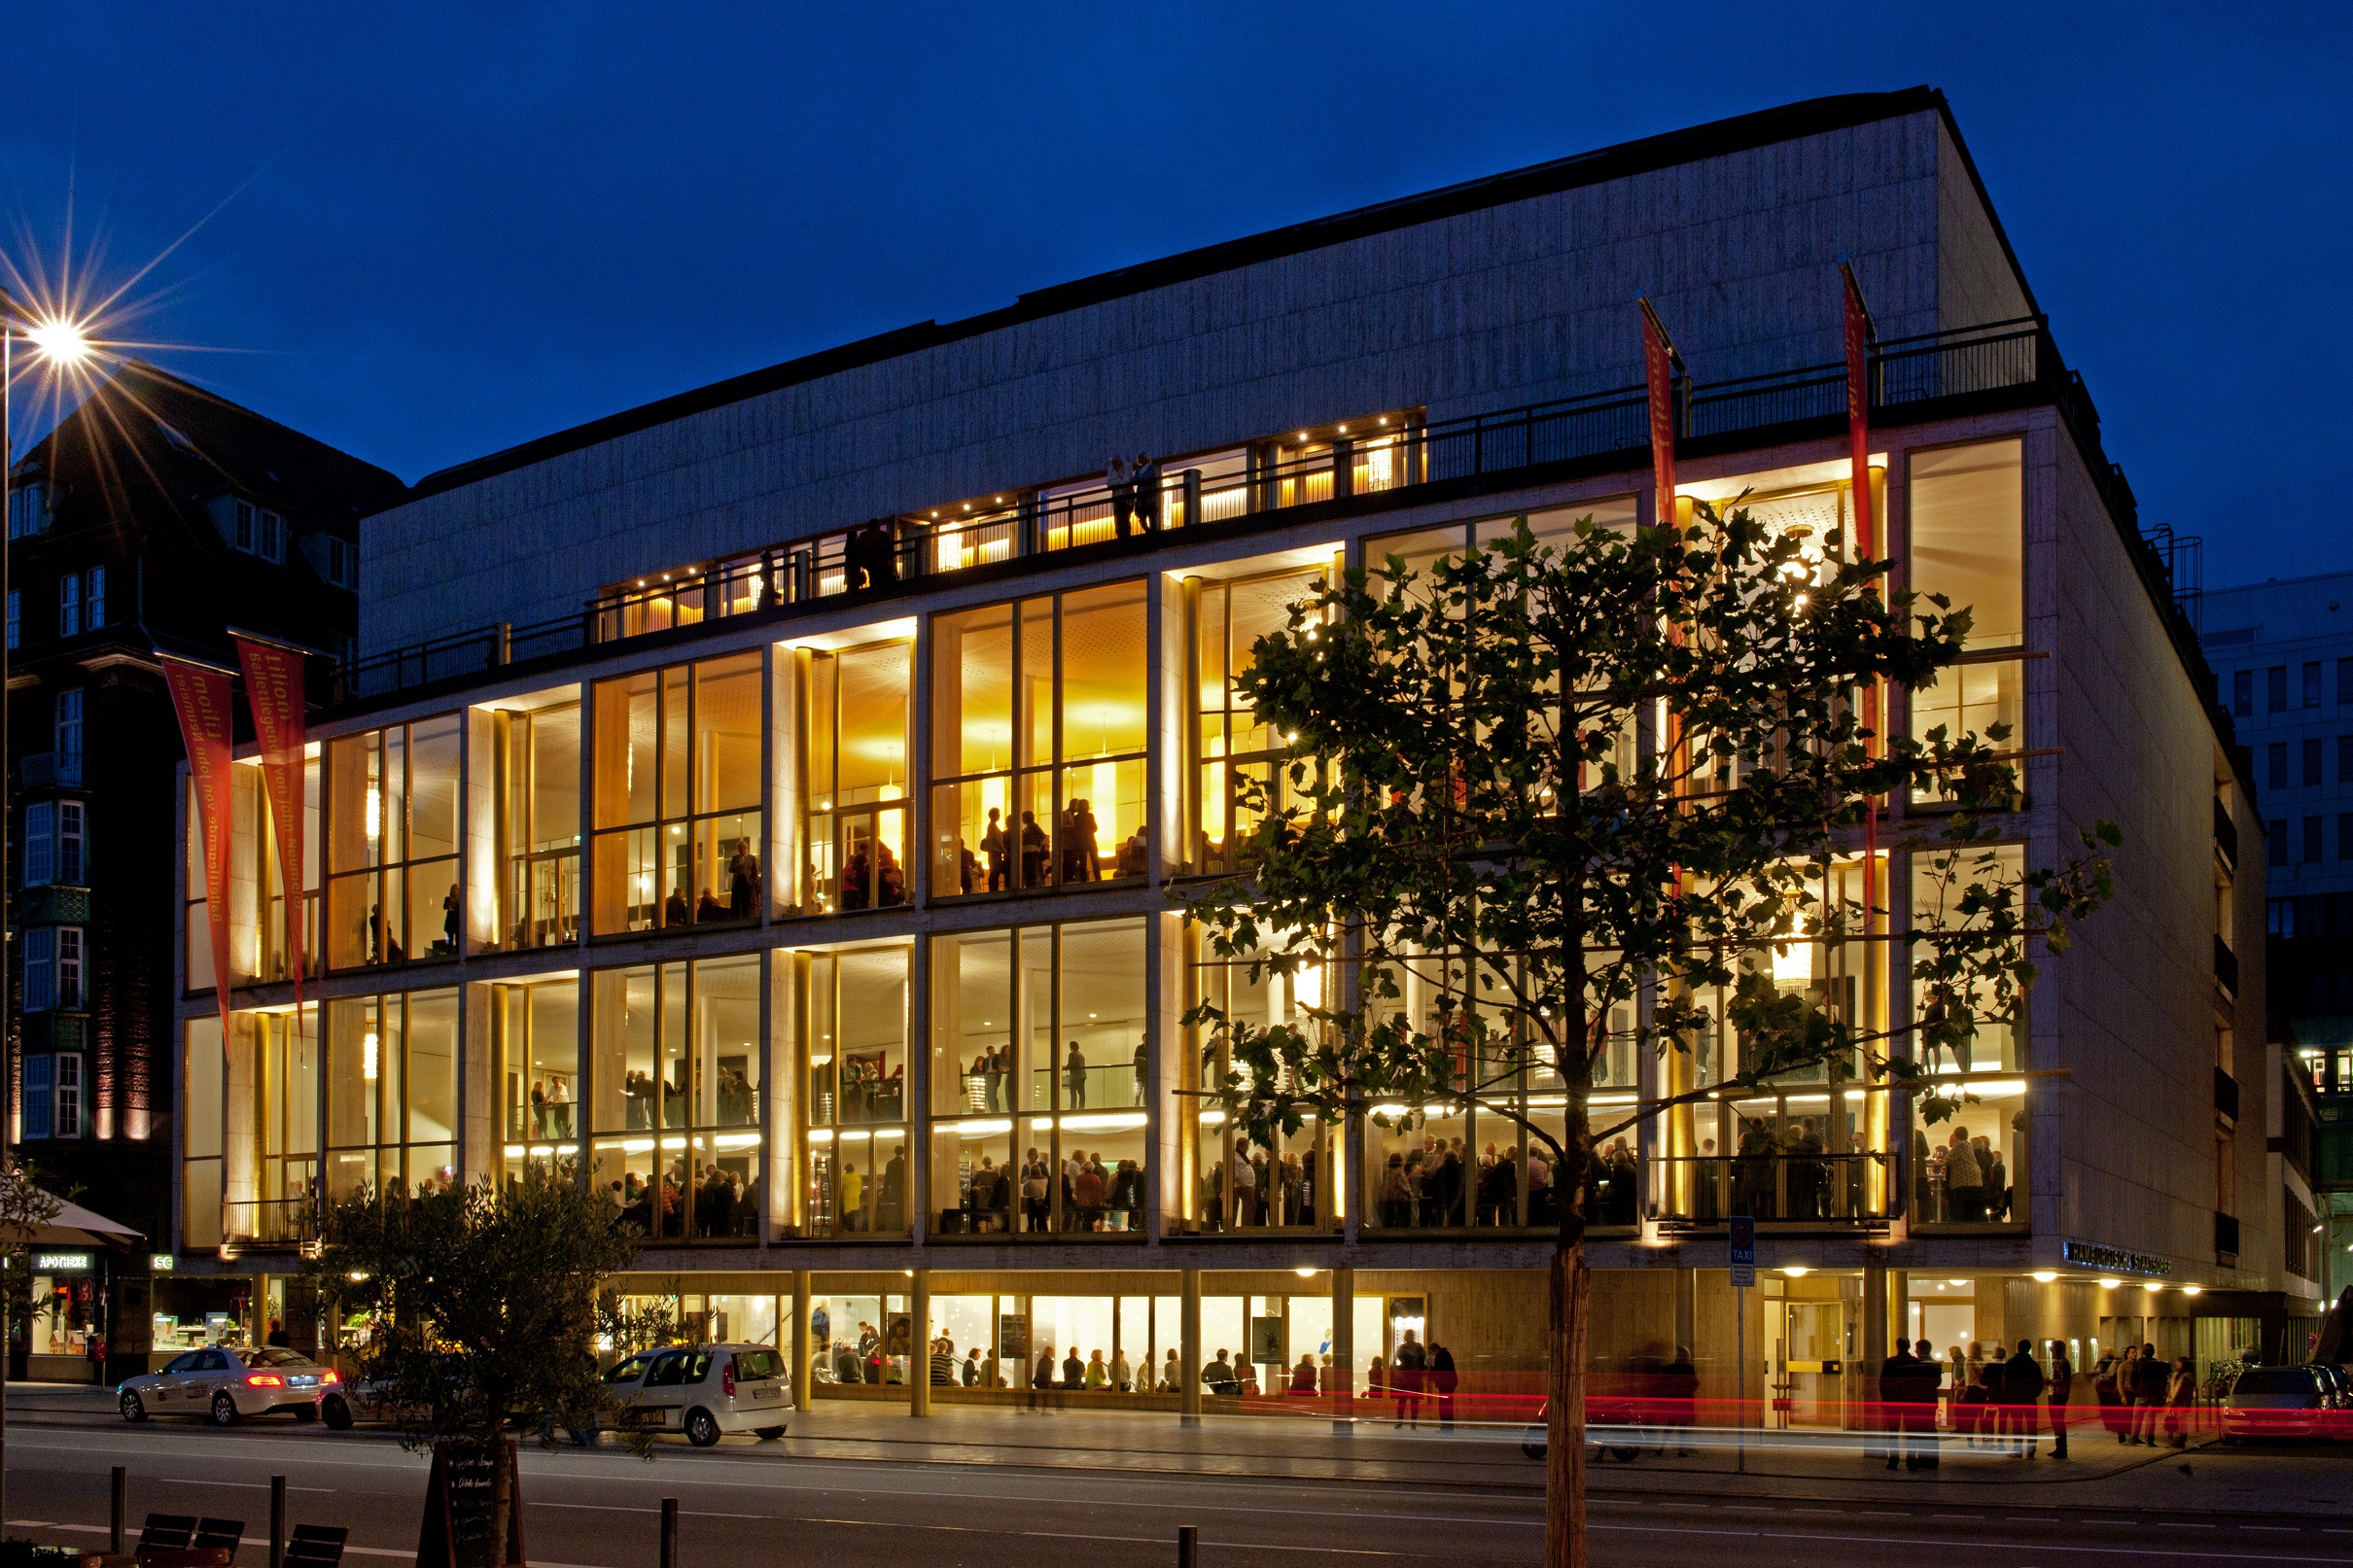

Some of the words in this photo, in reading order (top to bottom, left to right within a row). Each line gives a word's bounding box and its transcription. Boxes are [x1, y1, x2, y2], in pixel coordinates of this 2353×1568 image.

[265, 654, 291, 720] Liliom
[277, 798, 294, 832] John
[39, 1255, 88, 1269] APOTHEKE
[1733, 1249, 1752, 1261] TAXI
